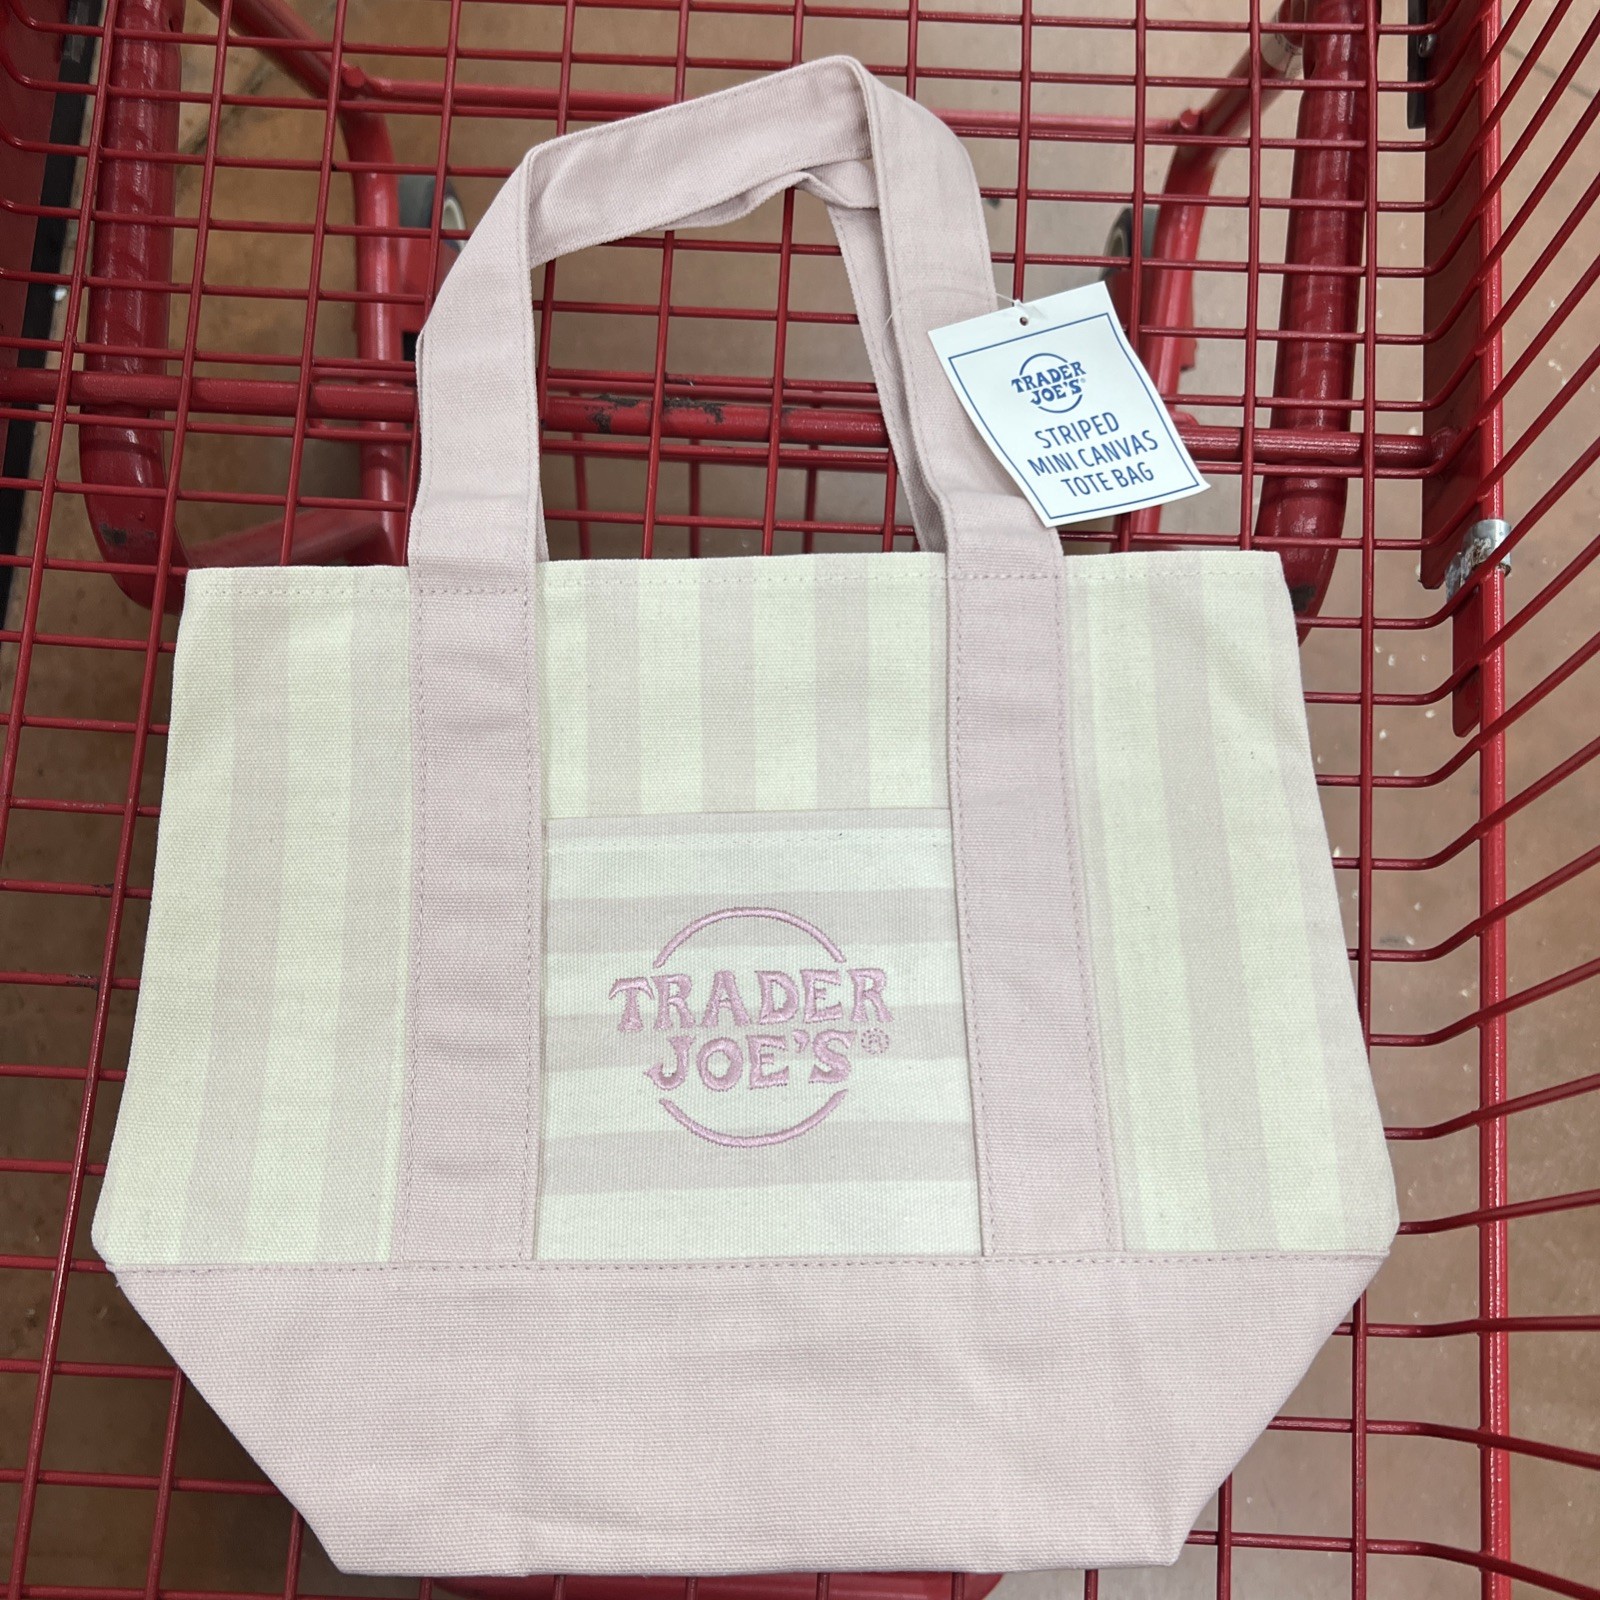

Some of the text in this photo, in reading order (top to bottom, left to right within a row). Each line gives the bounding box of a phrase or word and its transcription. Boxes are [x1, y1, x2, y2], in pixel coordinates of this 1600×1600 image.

[1011, 361, 1087, 393] TRADER
[1030, 378, 1082, 406] JOE'S
[1035, 412, 1120, 449] STRIPED
[1027, 429, 1159, 477] MINI CANVAS
[1060, 461, 1155, 497] TOTE BAG
[608, 968, 894, 1033] TRADER
[643, 1028, 857, 1092] JOE'S
